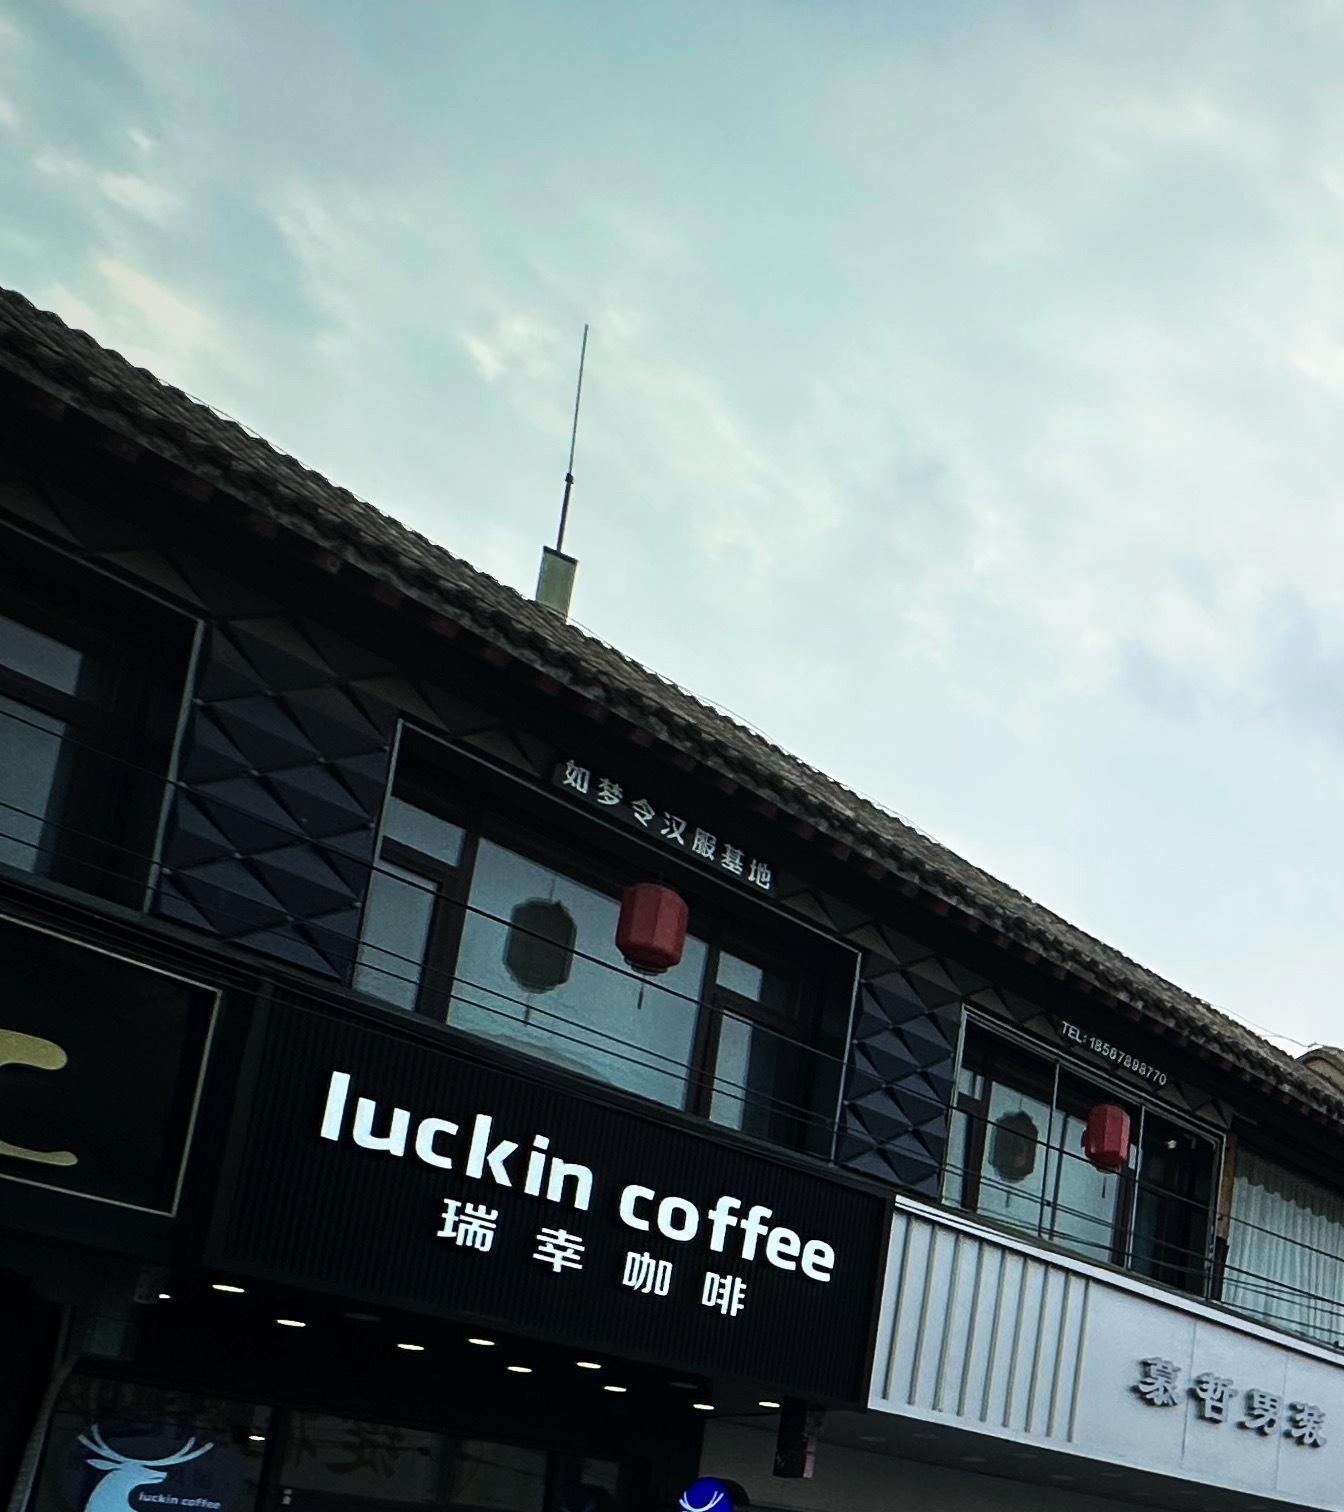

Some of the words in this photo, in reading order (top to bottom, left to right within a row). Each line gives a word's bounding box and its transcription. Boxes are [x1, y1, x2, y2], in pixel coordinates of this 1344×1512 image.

[562, 759, 772, 891] 如梦令汉服基地
[319, 1071, 593, 1212] luckin
[619, 1180, 837, 1284] coffee
[437, 1198, 748, 1319] 瑞幸咖啡
